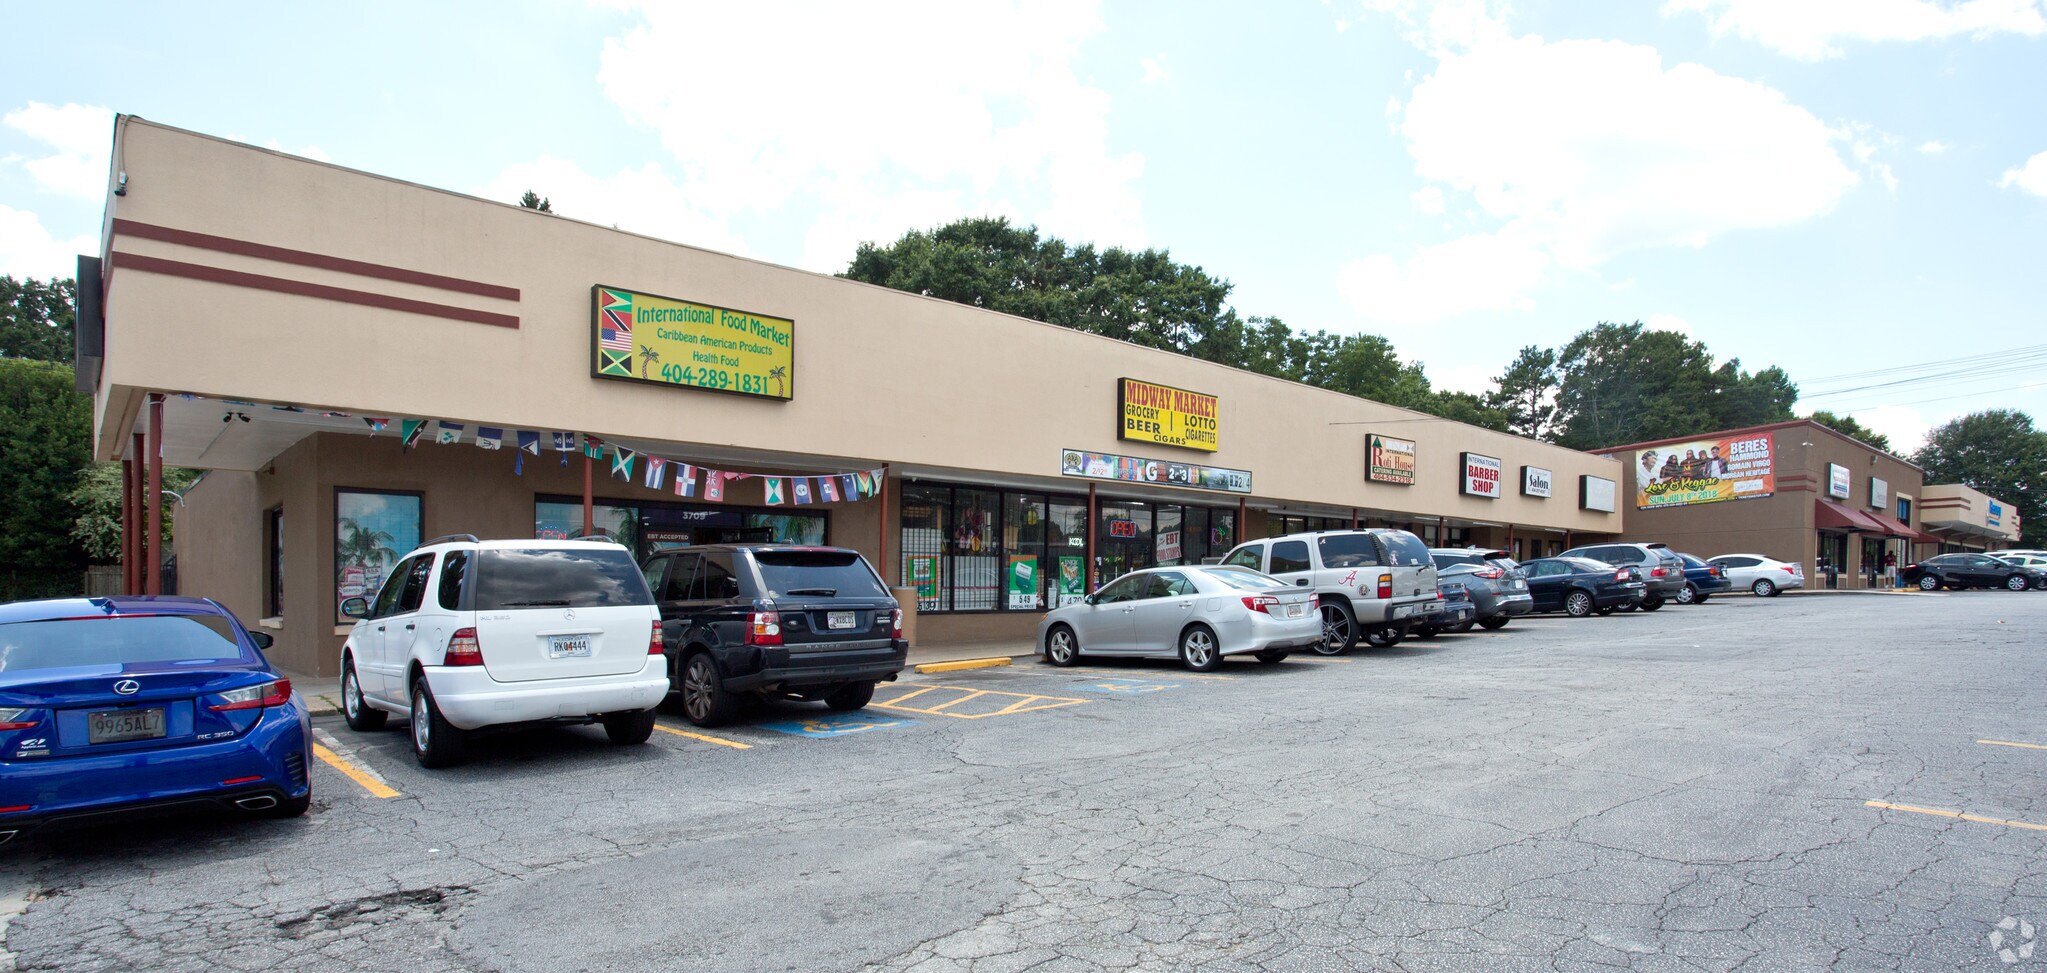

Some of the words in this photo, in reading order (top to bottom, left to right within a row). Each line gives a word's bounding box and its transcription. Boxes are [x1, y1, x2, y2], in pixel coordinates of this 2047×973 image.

[637, 306, 714, 325] International
[721, 309, 746, 332] Food
[750, 318, 789, 347] Market
[657, 327, 698, 344] Caribbean
[700, 334, 737, 350] American
[739, 342, 772, 356] Products
[693, 350, 718, 365] Health
[720, 355, 739, 367] Food
[661, 363, 768, 394] 404-289-1831
[1126, 381, 1171, 411] MIDWAY
[1174, 390, 1217, 418] MARKET
[1126, 404, 1159, 420] GROCERY
[1127, 417, 1161, 434] BEER
[1184, 414, 1216, 430] LOTTO
[1153, 434, 1186, 445] CIGARS
[1185, 428, 1216, 444] CIGARETTES
[1730, 438, 1768, 454] BERES
[1372, 447, 1391, 468] Roti
[1394, 456, 1413, 470] House
[1468, 456, 1499, 468] INTERNATIONAL
[1730, 450, 1769, 462] HAMMOND
[1728, 462, 1751, 471] ROMAIN
[1752, 459, 1771, 467] VIRGO
[1468, 465, 1499, 482] BARBER
[1472, 479, 1494, 493] SHOP
[1529, 475, 1549, 489] Salon
[1644, 478, 1669, 495] Love
[1680, 476, 1720, 491] Reggae
[1697, 490, 1718, 500] 2018
[683, 511, 706, 520] 3709
[1111, 521, 1136, 537] OPEN
[1068, 537, 1084, 547] KOOL
[1166, 532, 1179, 545] EBT
[96, 714, 160, 735] 9965AL7
[213, 730, 234, 738] 350
